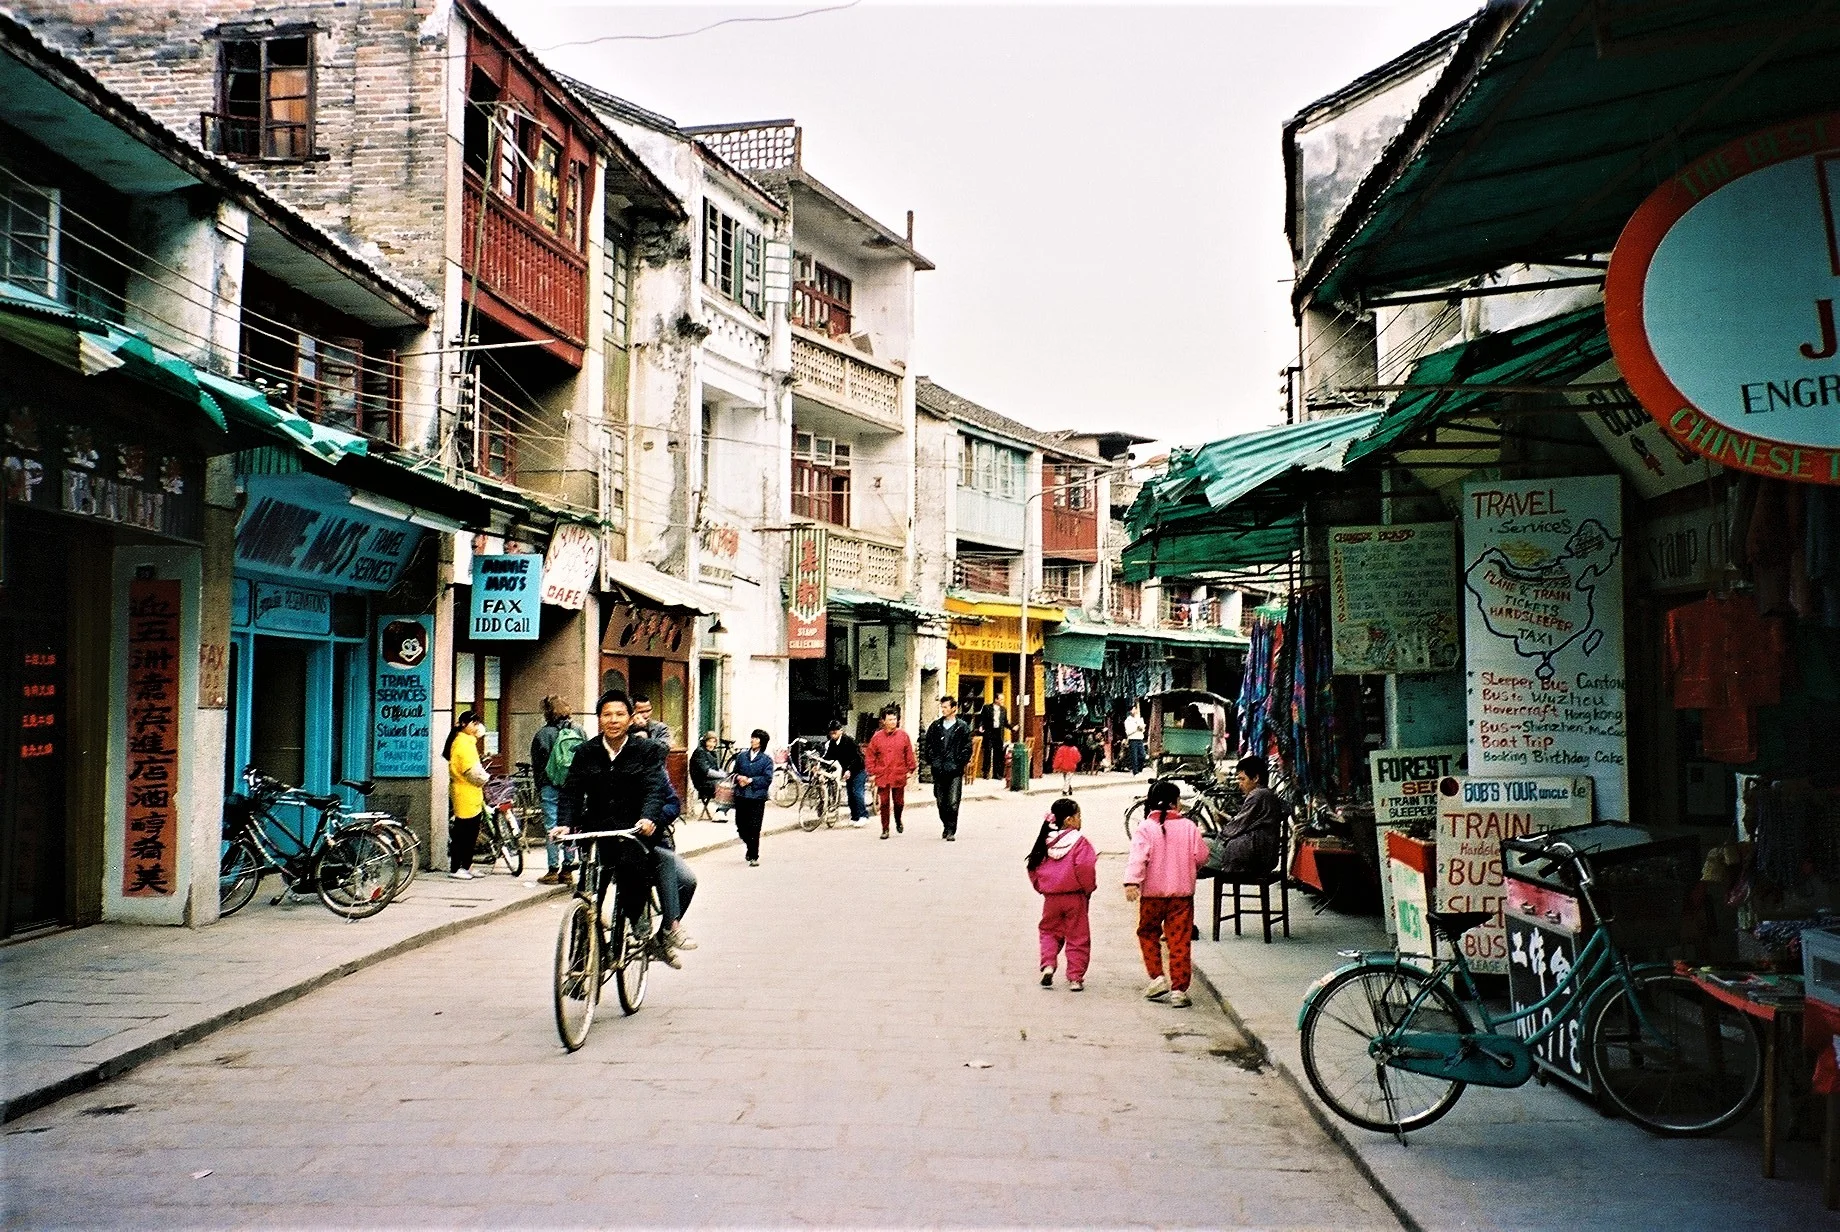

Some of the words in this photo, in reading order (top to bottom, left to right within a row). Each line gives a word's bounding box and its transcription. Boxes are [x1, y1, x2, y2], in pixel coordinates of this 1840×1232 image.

[1670, 407, 1814, 480] CHINESE
[1472, 488, 1567, 519] TRAVEL
[1497, 519, 1573, 535] Services
[367, 527, 407, 557] TRAVEL
[350, 556, 398, 584] SERVICES
[481, 559, 530, 574] MINNIE
[484, 576, 527, 591] MAO'S
[546, 585, 581, 605] CAFE
[1533, 589, 1571, 601] TRAIN
[482, 599, 522, 613] FAX
[1504, 595, 1560, 617] TICKETS
[475, 618, 501, 632] IDD
[504, 617, 530, 632] Call
[1489, 606, 1575, 631] HARDSLEEPER
[1518, 628, 1553, 646] TAXI
[381, 674, 423, 689] TRAVEL
[1541, 677, 1568, 693] Bus
[377, 688, 428, 702] SERVICES
[1482, 688, 1509, 702] Bus
[1480, 720, 1510, 734] Bus
[1480, 735, 1517, 749] Boat
[1522, 734, 1554, 751] Trip
[1532, 750, 1590, 768] Birthday
[1594, 750, 1624, 765] Cake
[1377, 754, 1453, 783] FOREST
[1464, 781, 1500, 802] BOB'S
[1503, 780, 1539, 802] YOUR
[1389, 796, 1419, 806] TRAIN
[1443, 812, 1531, 839] TRAIN
[1448, 858, 1505, 886] BUS
[1465, 934, 1507, 958] BUS
